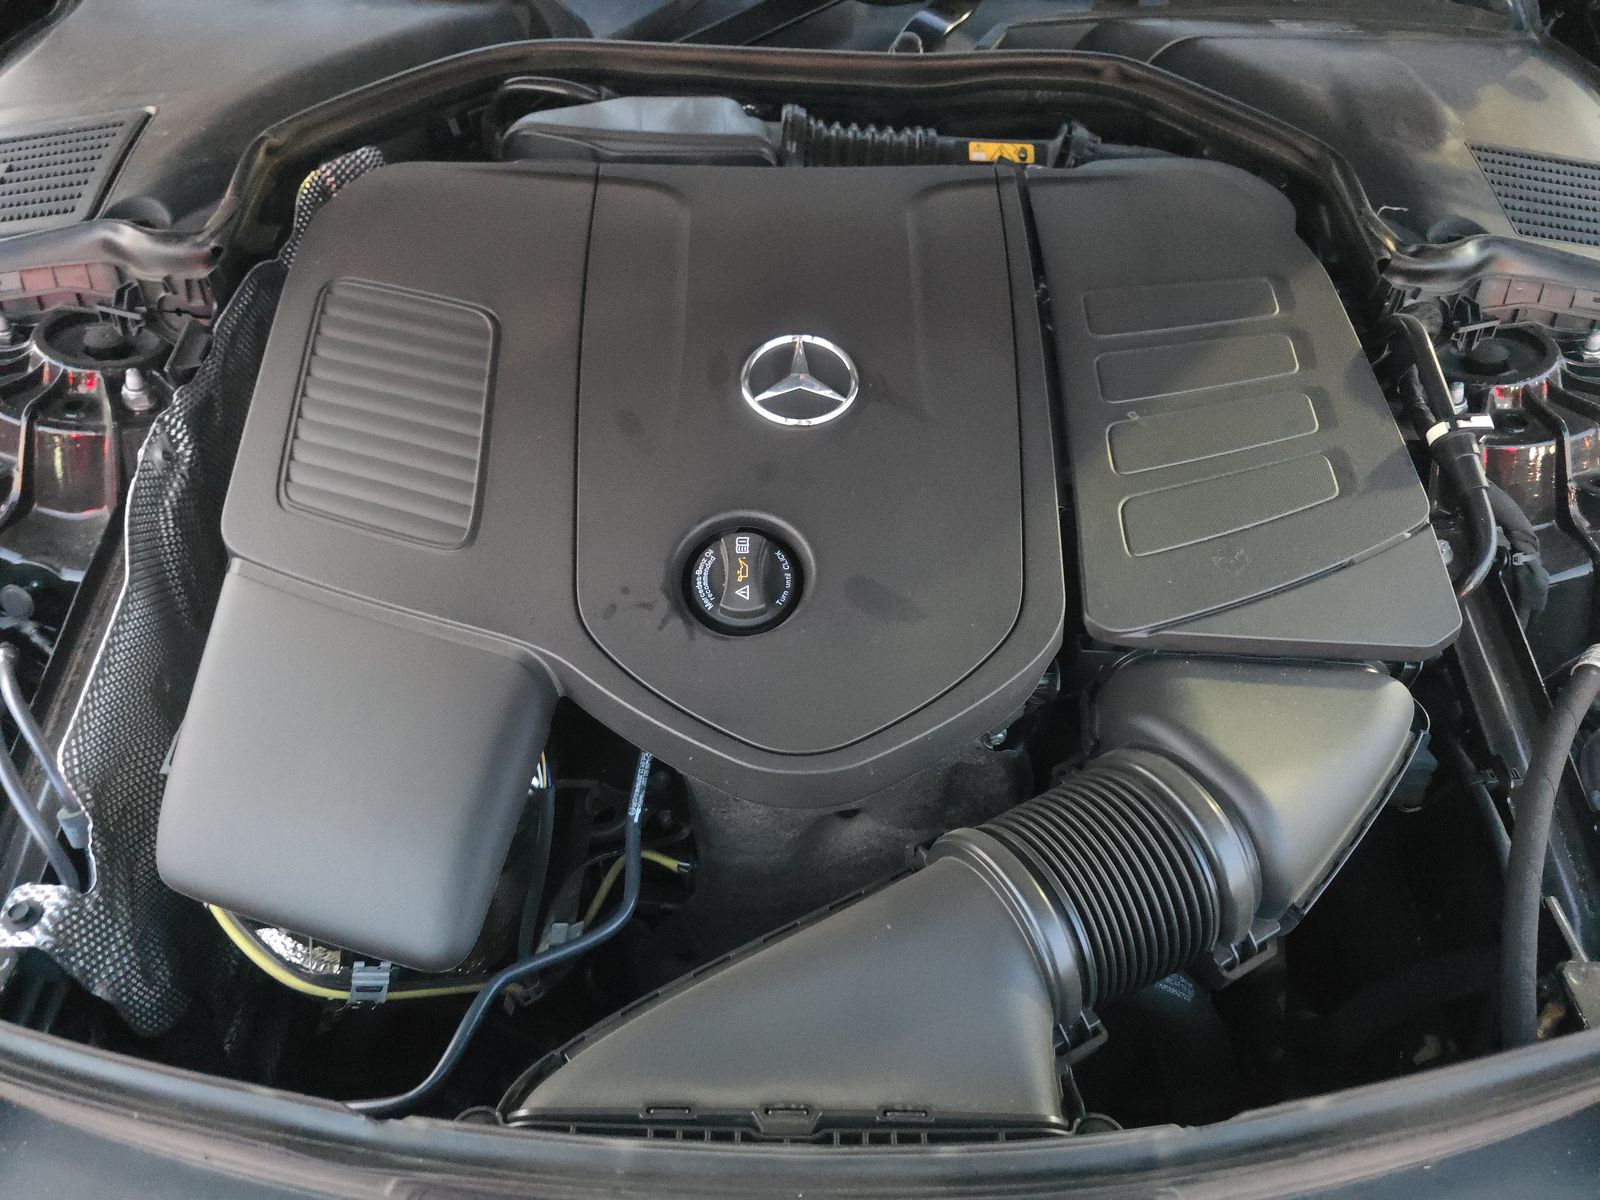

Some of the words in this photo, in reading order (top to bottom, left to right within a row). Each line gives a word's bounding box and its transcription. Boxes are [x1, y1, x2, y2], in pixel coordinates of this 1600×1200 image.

[704, 548, 714, 558] Oil
[774, 550, 790, 570] CLICK
[695, 558, 714, 611] Mercedes-Benz
[702, 556, 716, 601] recommended
[775, 590, 789, 606] Turn
